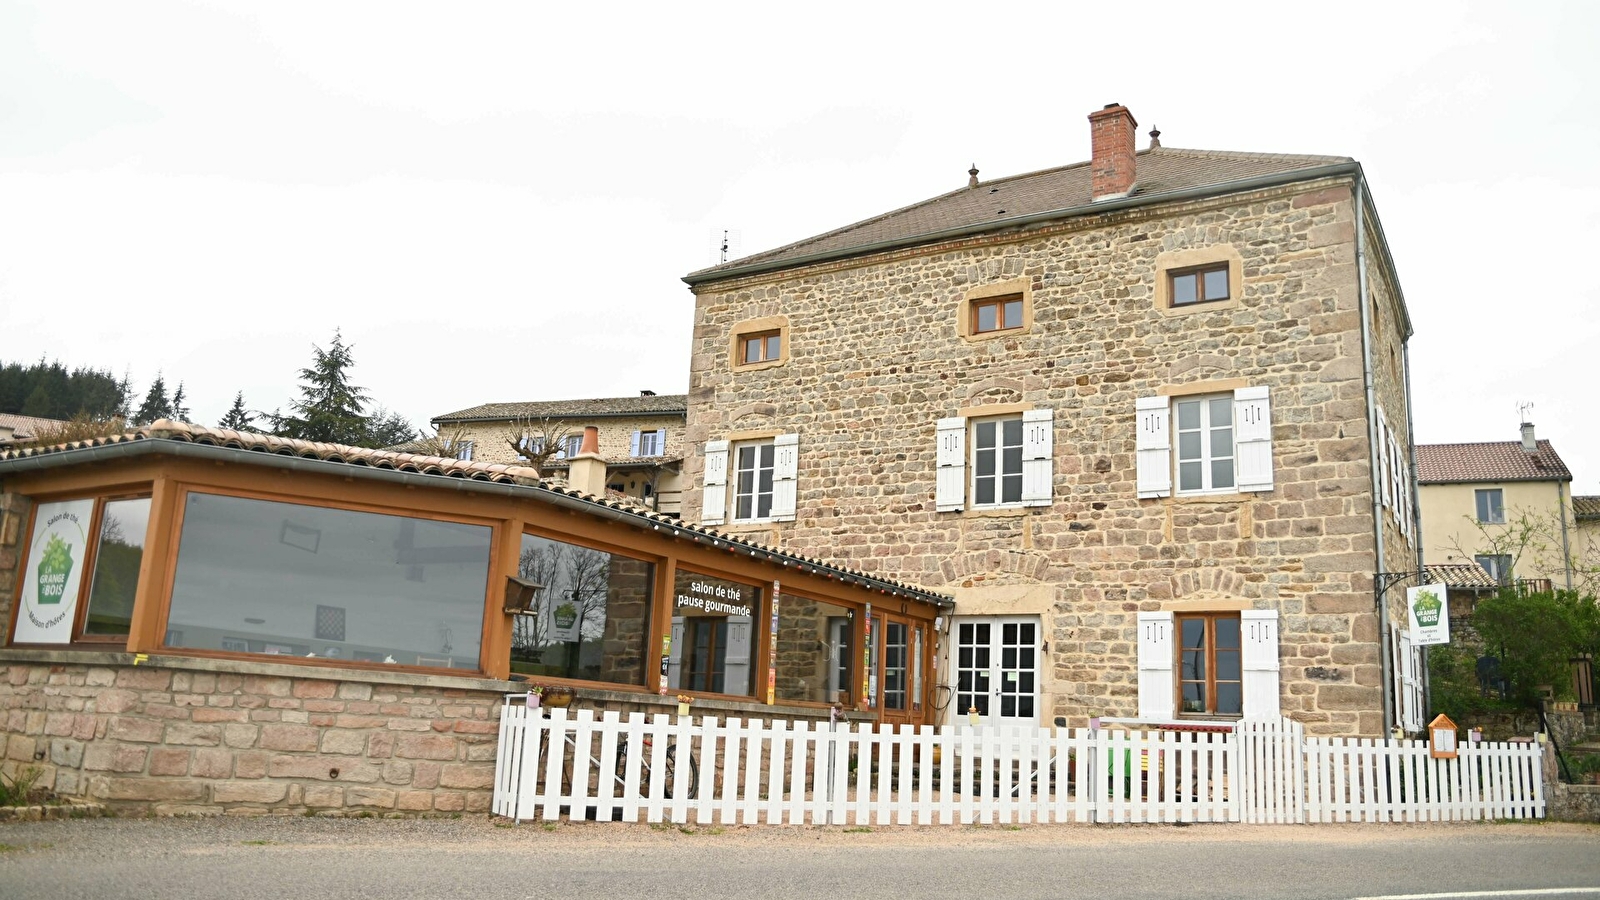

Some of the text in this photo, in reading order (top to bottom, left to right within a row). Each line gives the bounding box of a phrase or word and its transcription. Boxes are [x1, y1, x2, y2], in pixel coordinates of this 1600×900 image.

[47, 511, 79, 527] Salon de thé
[45, 565, 52, 574] LA
[40, 573, 65, 584] GRANGE
[45, 584, 63, 596] BOIS
[691, 581, 741, 600] salon de thé
[678, 594, 751, 617] pause gourmande
[28, 610, 45, 629] Maison
